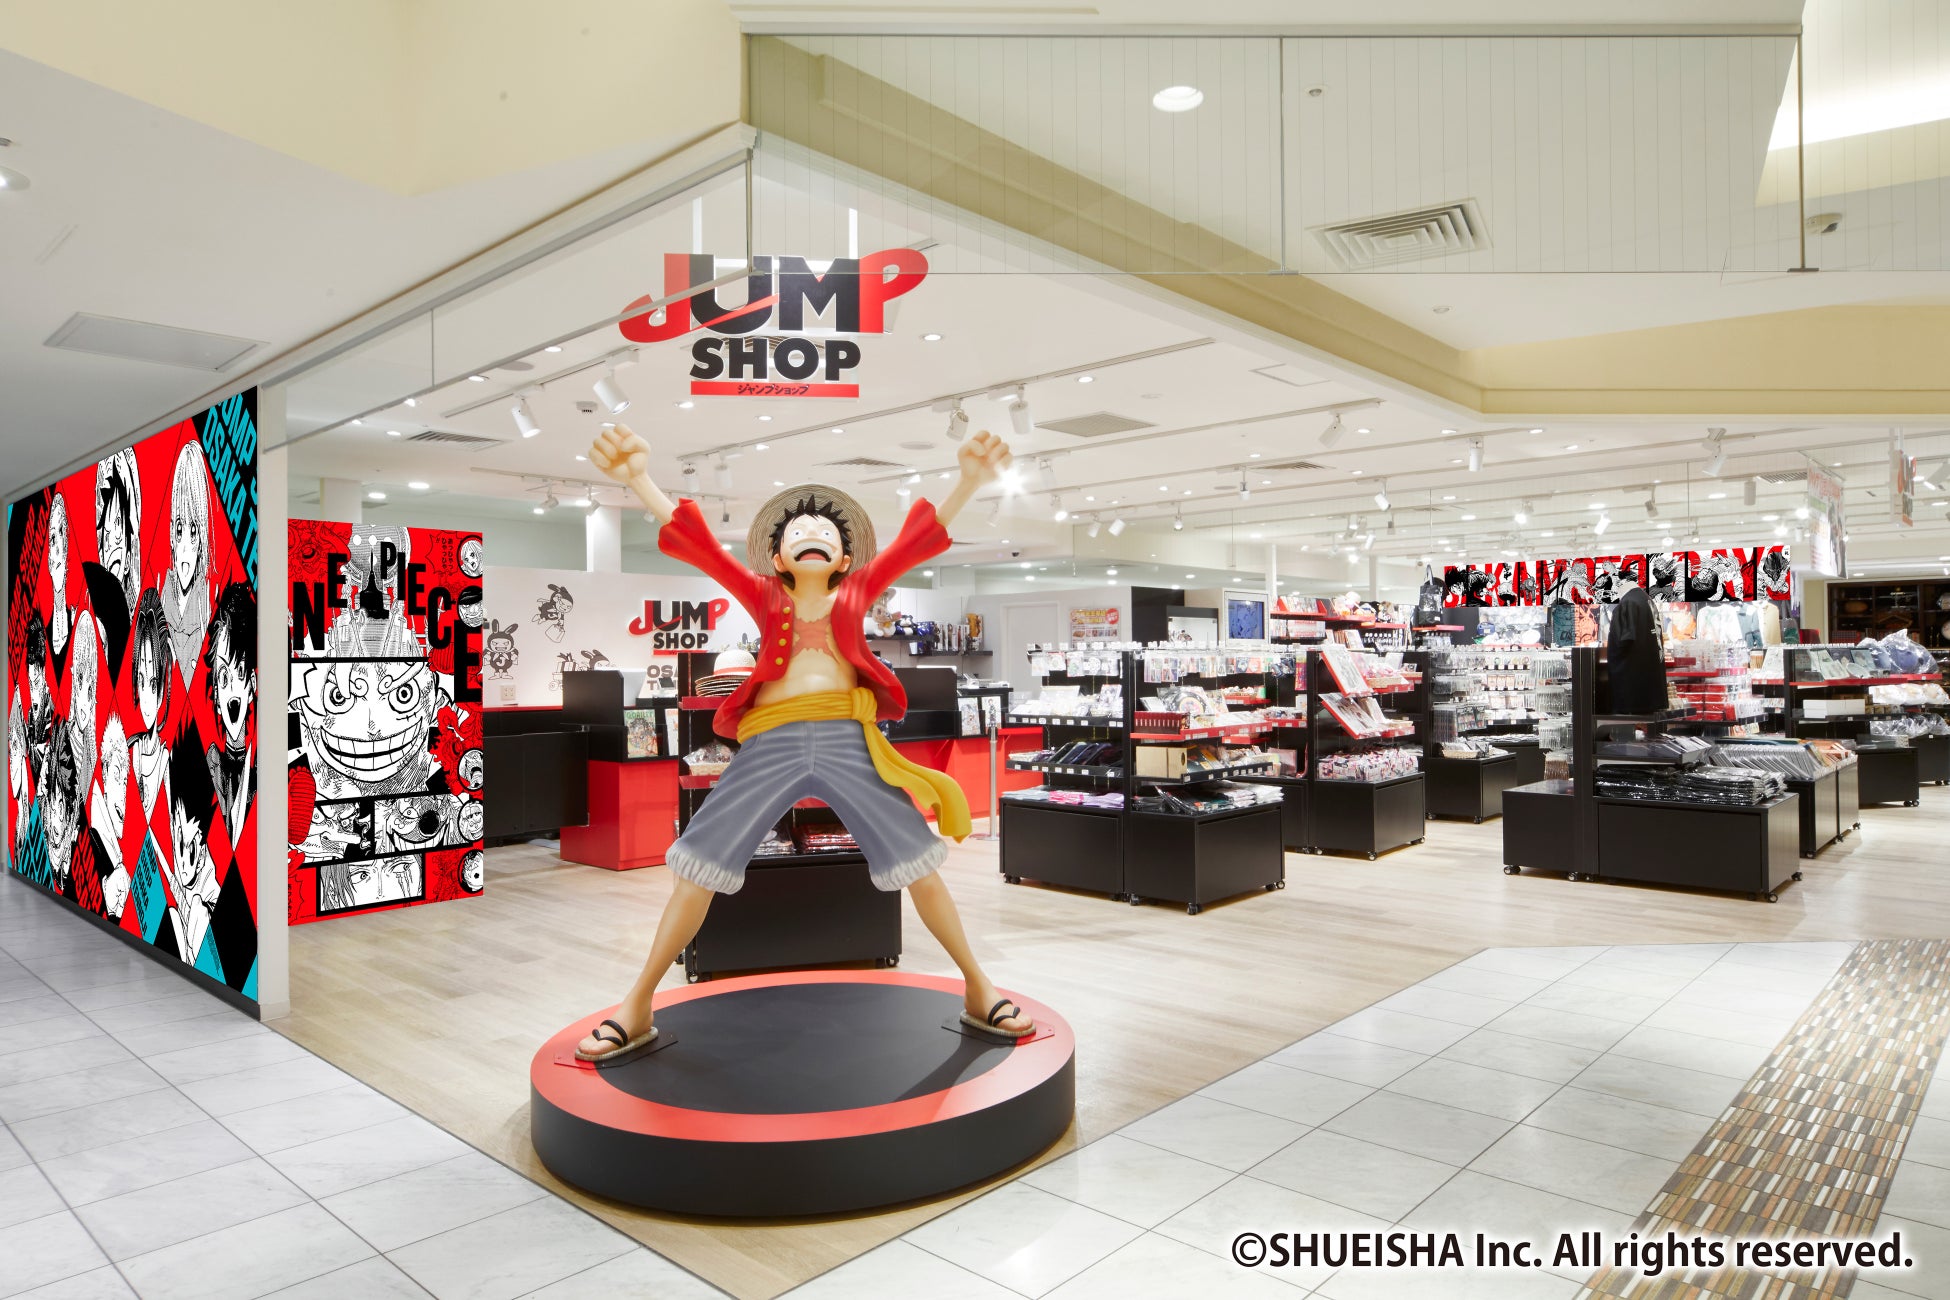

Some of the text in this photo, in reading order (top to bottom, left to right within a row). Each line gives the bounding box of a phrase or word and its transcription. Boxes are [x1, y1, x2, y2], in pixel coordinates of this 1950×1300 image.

[618, 248, 929, 343] JUMP
[690, 337, 861, 381] SHOP
[737, 384, 810, 395] ジャンプショップ
[380, 541, 482, 703] PIECE
[628, 597, 730, 636] JUMP
[653, 632, 709, 649] SHOP
